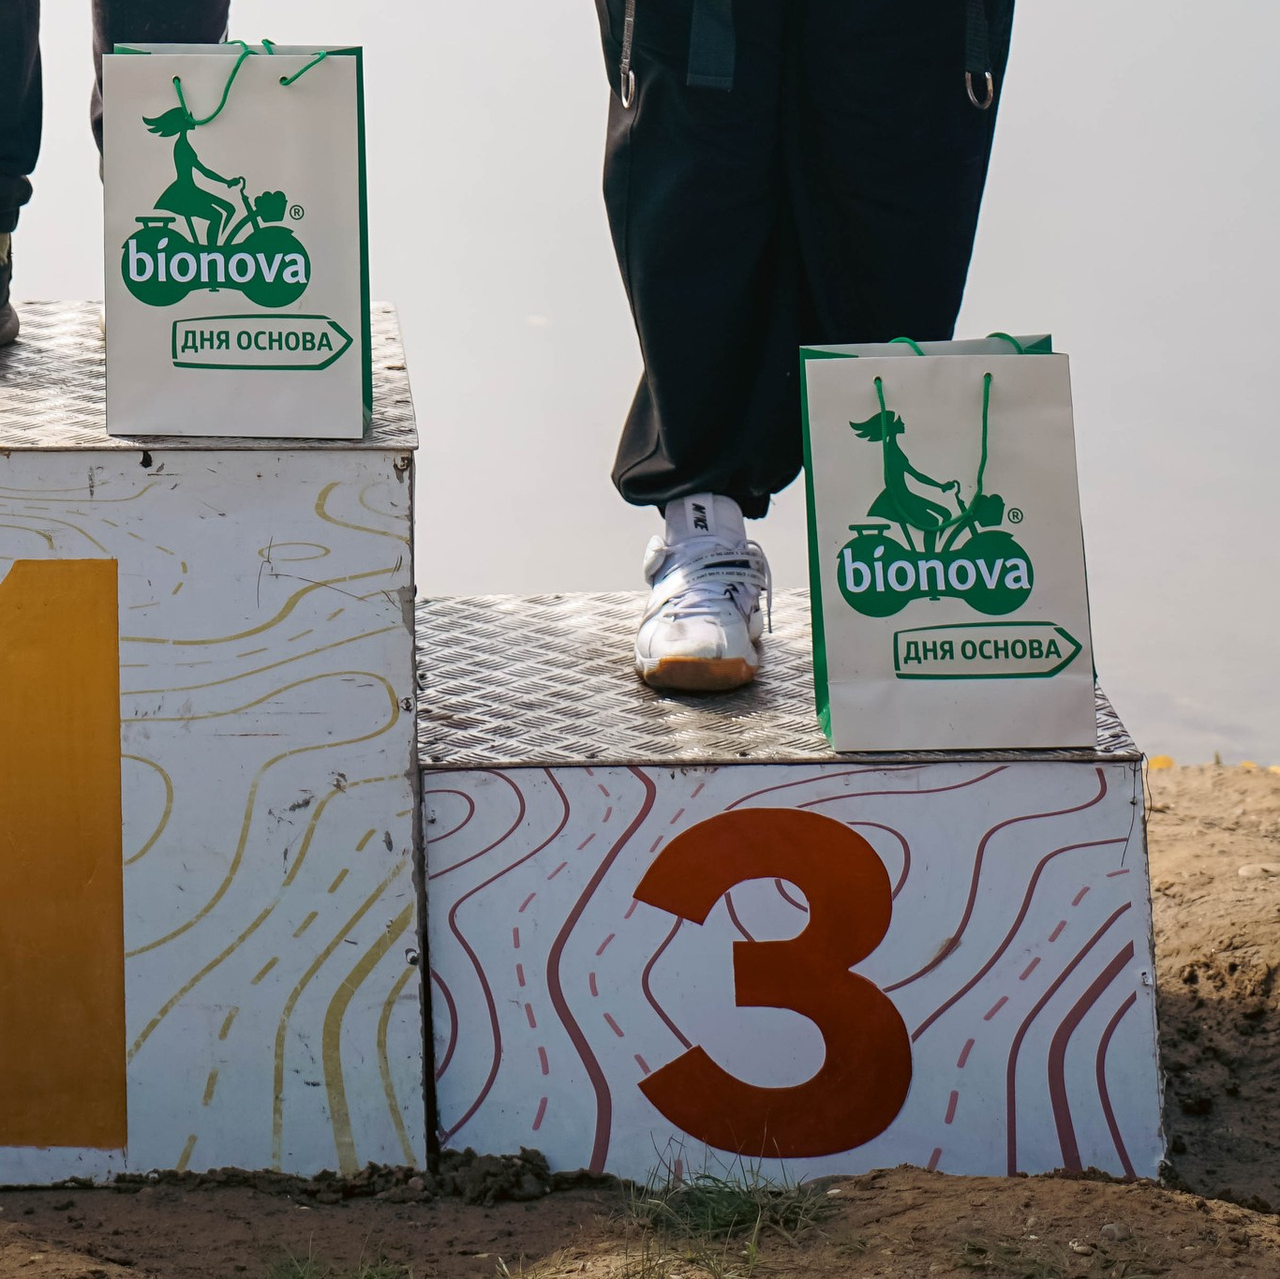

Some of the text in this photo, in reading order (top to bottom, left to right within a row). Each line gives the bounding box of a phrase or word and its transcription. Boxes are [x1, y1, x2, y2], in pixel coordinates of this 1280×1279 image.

[127, 237, 308, 285] bionova
[181, 330, 334, 353] ДНЯ ОСНОВА
[842, 545, 1031, 592] bionova
[903, 638, 1062, 665] ДНЯ ОСНОВА
[633, 807, 913, 1159] 3
